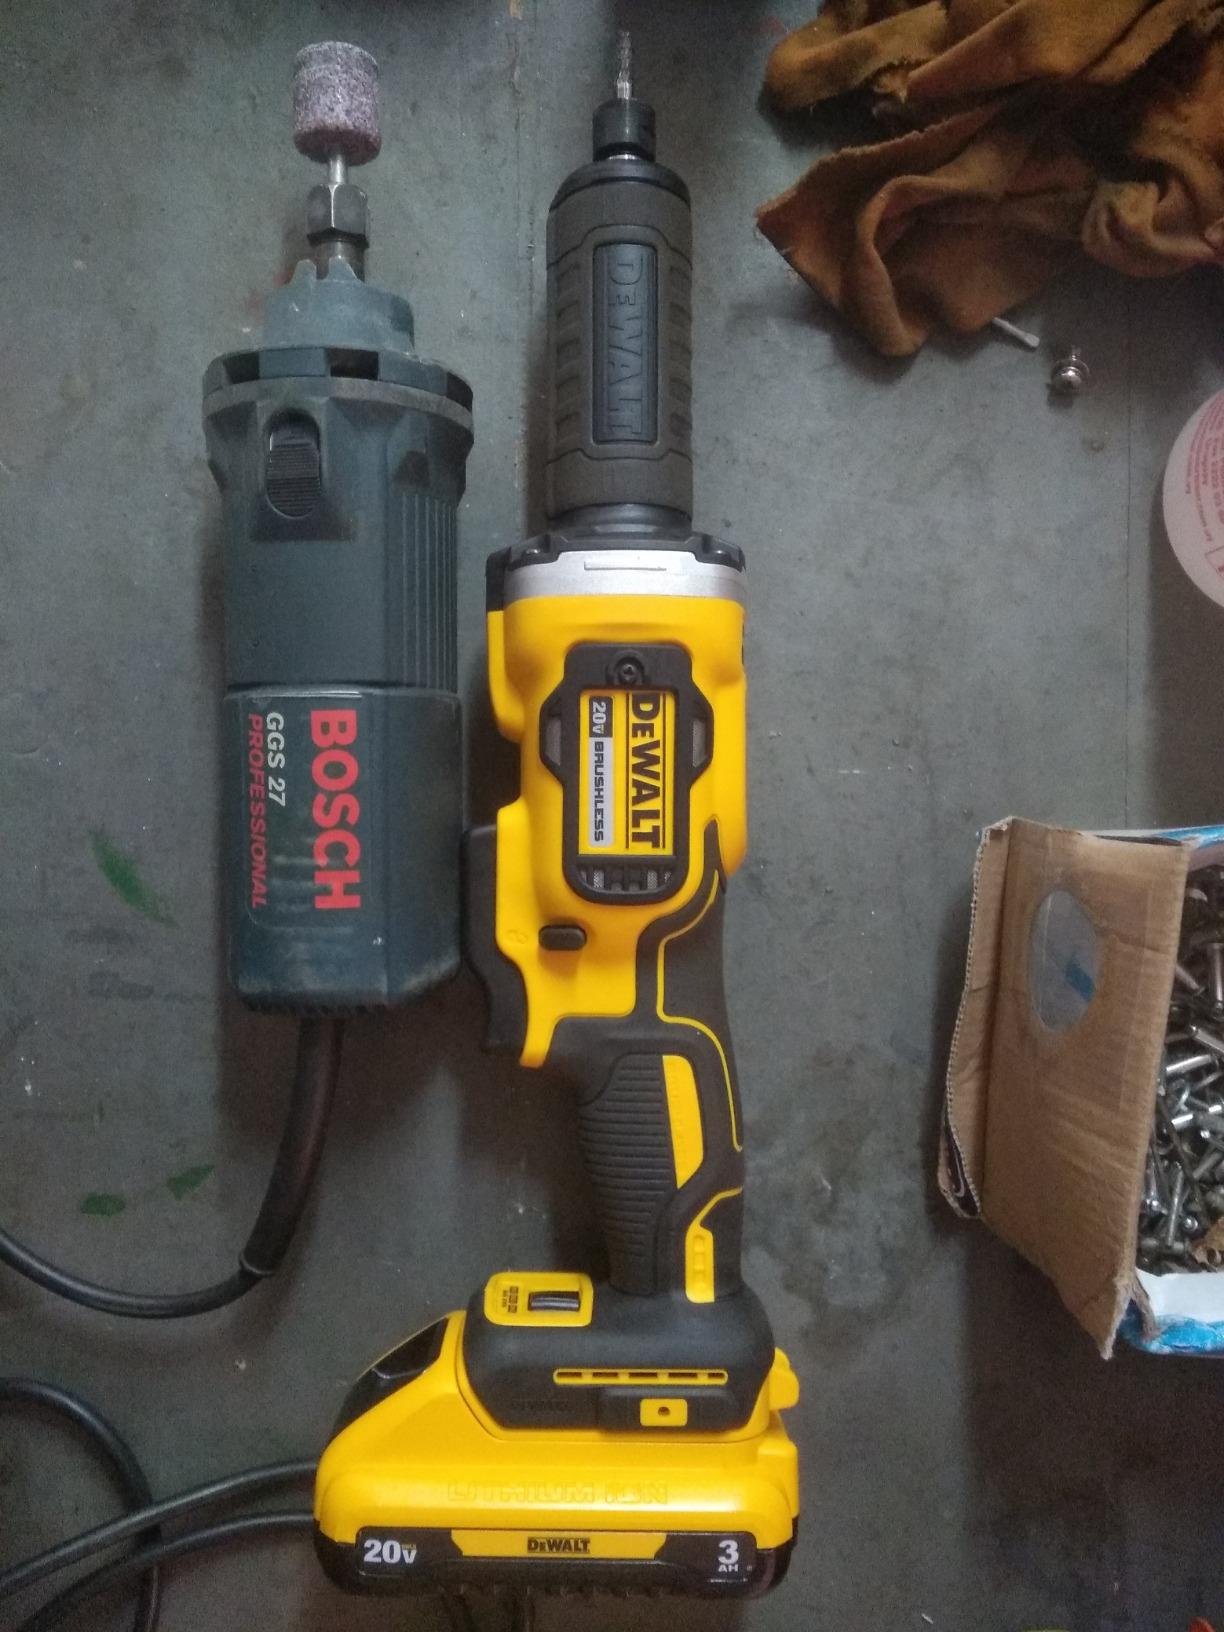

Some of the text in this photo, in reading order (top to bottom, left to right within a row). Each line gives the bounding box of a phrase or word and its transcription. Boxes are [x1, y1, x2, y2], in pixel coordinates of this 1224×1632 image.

[266, 711, 286, 807] GGS 27
[593, 741, 605, 842] BRUSHLESS
[248, 713, 267, 908] PROFESSIONAL
[310, 709, 362, 910] BOSCH
[447, 1480, 594, 1503] LITHIUM
[718, 1539, 739, 1564] 3
